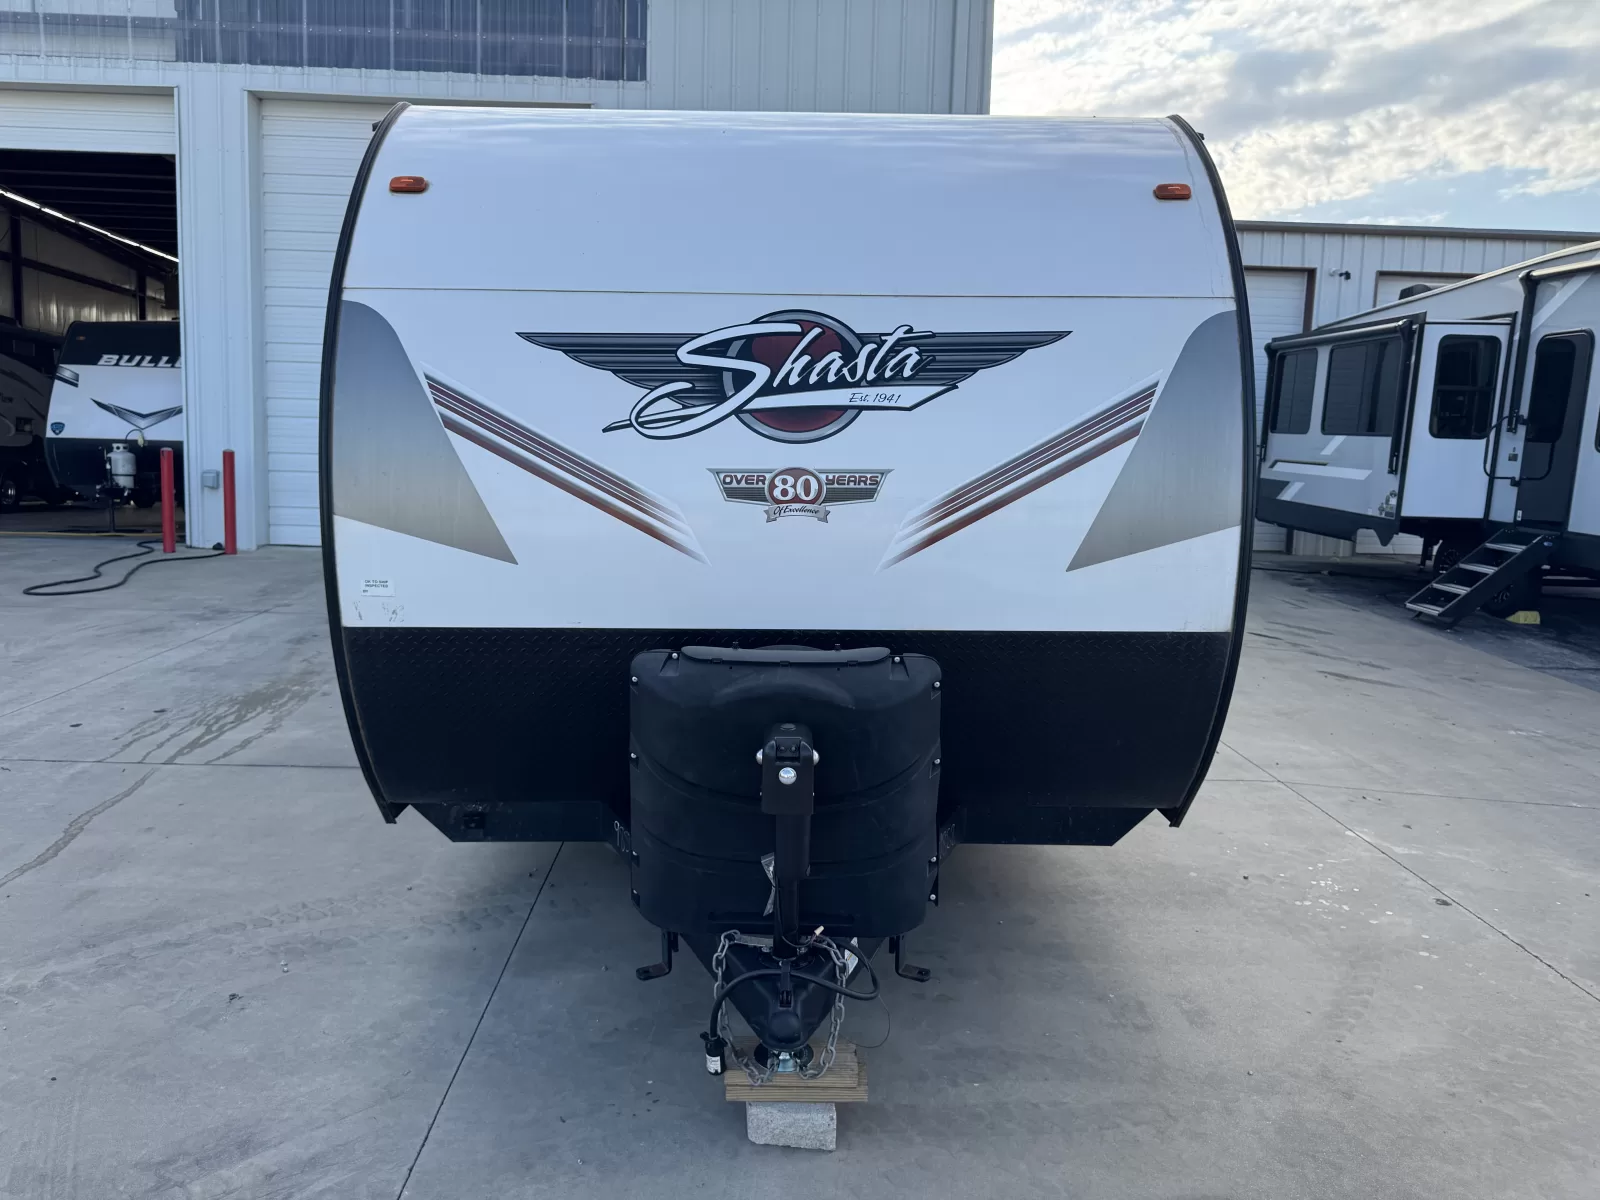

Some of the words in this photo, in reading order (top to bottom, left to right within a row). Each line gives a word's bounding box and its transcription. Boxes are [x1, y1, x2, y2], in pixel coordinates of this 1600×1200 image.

[602, 322, 938, 440] Shasta
[849, 392, 870, 402] Est.
[873, 393, 901, 403] 1941
[722, 474, 766, 486] OVER
[772, 475, 819, 501] 80
[825, 474, 879, 486] YEARS
